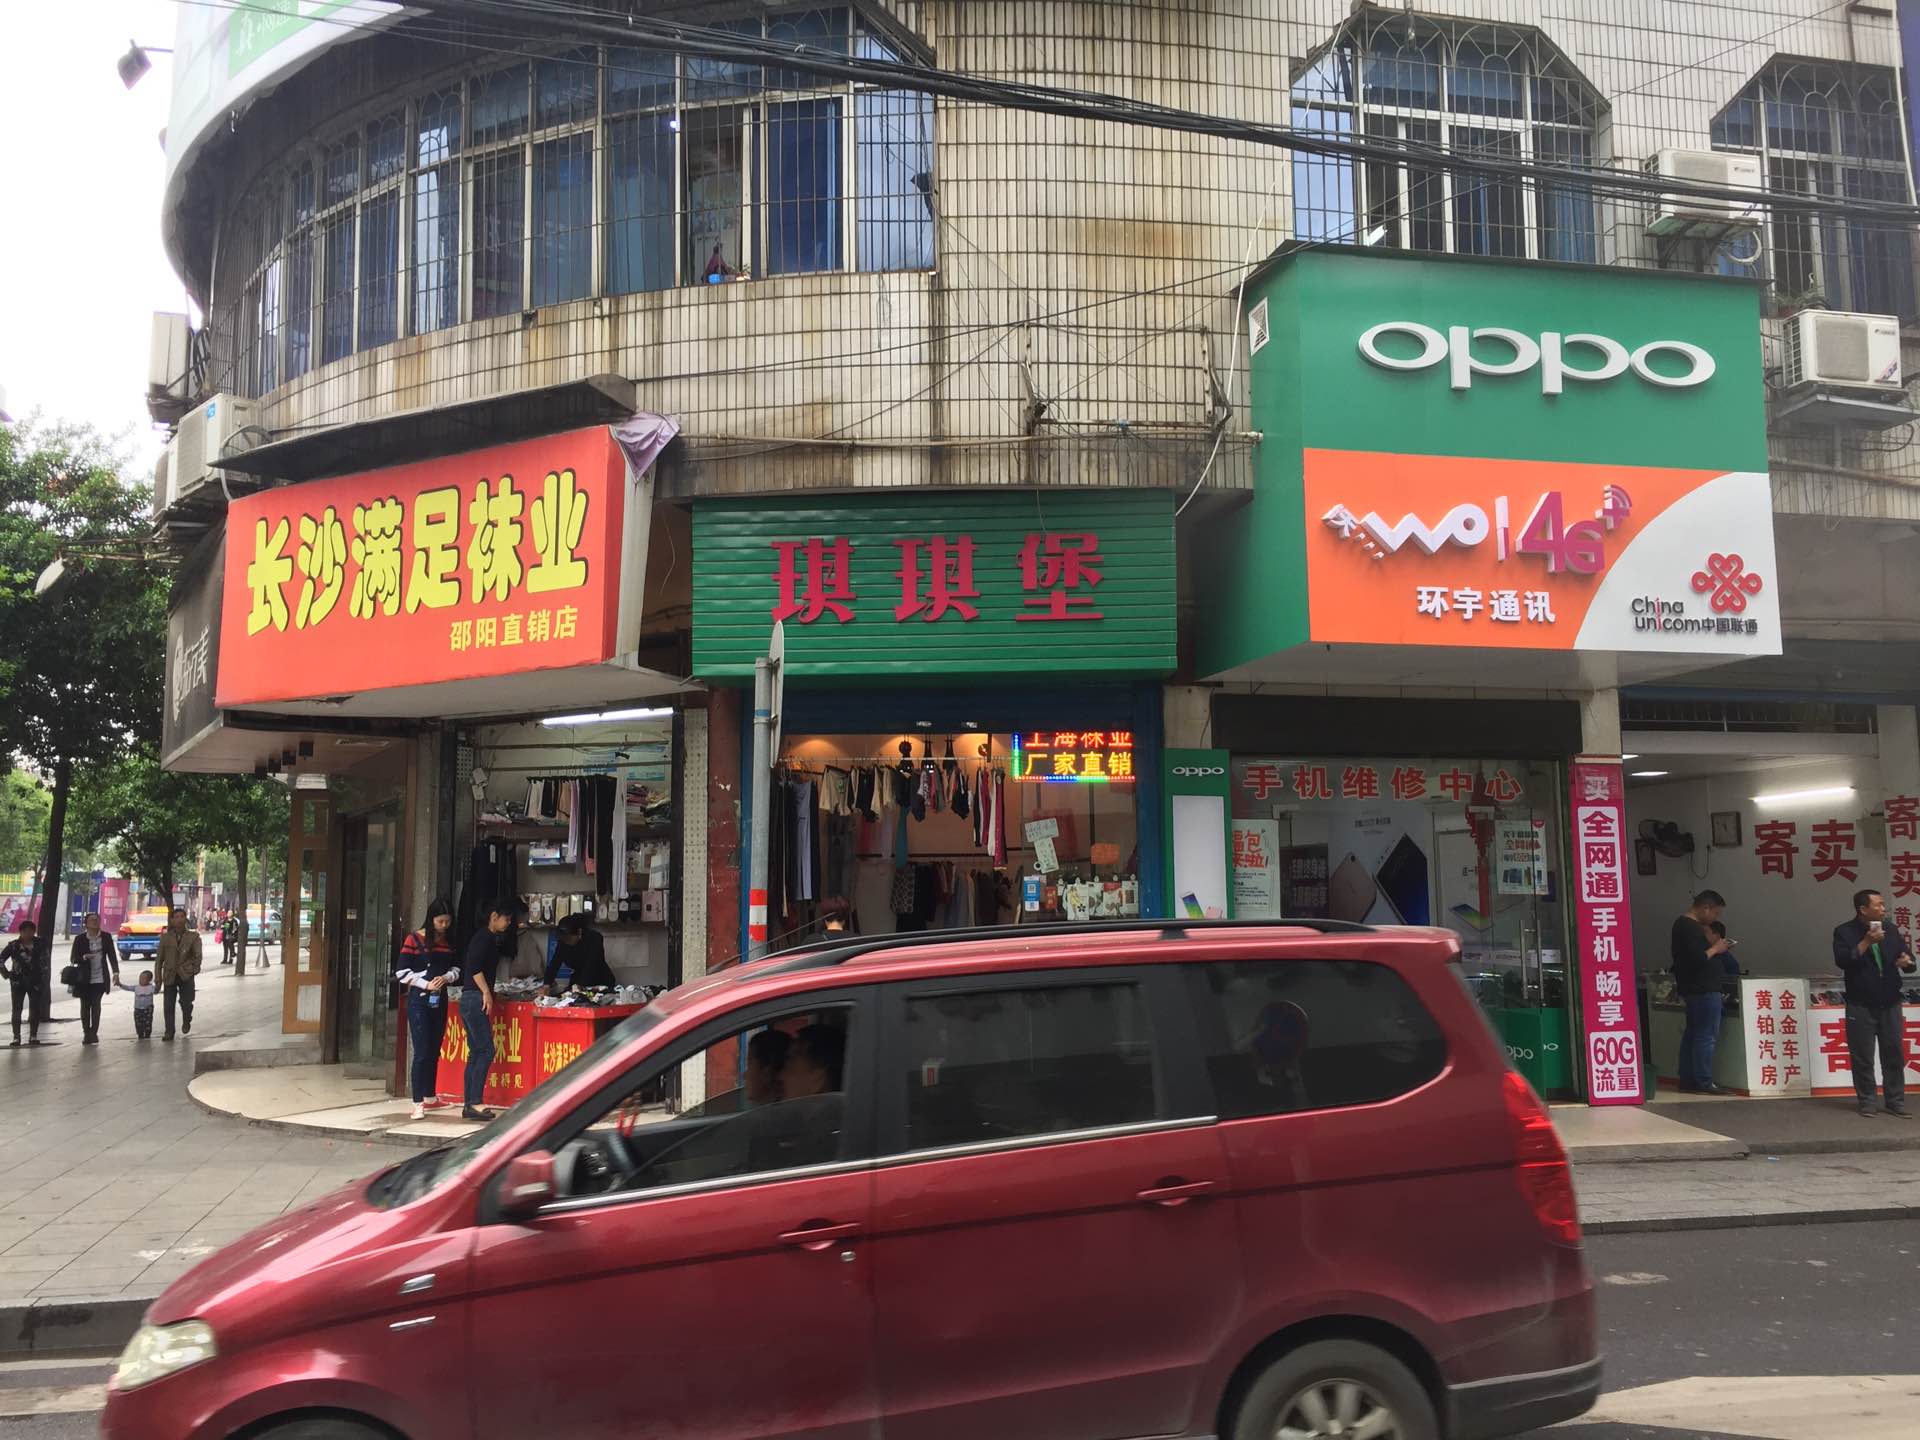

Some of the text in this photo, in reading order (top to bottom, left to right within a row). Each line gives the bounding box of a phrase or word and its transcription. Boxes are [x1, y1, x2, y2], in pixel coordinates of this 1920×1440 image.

[246, 468, 590, 637] 长沙满足袜业
[769, 532, 1105, 625] 琪琪堡
[1416, 586, 1556, 623] 环宇通讯
[1631, 597, 1684, 616] China
[450, 605, 579, 652] 邵阳直销店
[1701, 617, 1759, 634] 中国联通
[1025, 751, 1133, 776] 厂家直销
[1243, 765, 1523, 801] 手机维修中心
[1754, 819, 1859, 883] 寄卖
[1885, 794, 1920, 898] 寄卖
[1756, 990, 1796, 1010] 黄金
[1757, 1014, 1798, 1035] 铂金
[1592, 1036, 1635, 1066] 60G
[1758, 1039, 1800, 1061] 汽车
[1595, 1067, 1638, 1093] 流量
[1760, 1064, 1801, 1085] 房产
